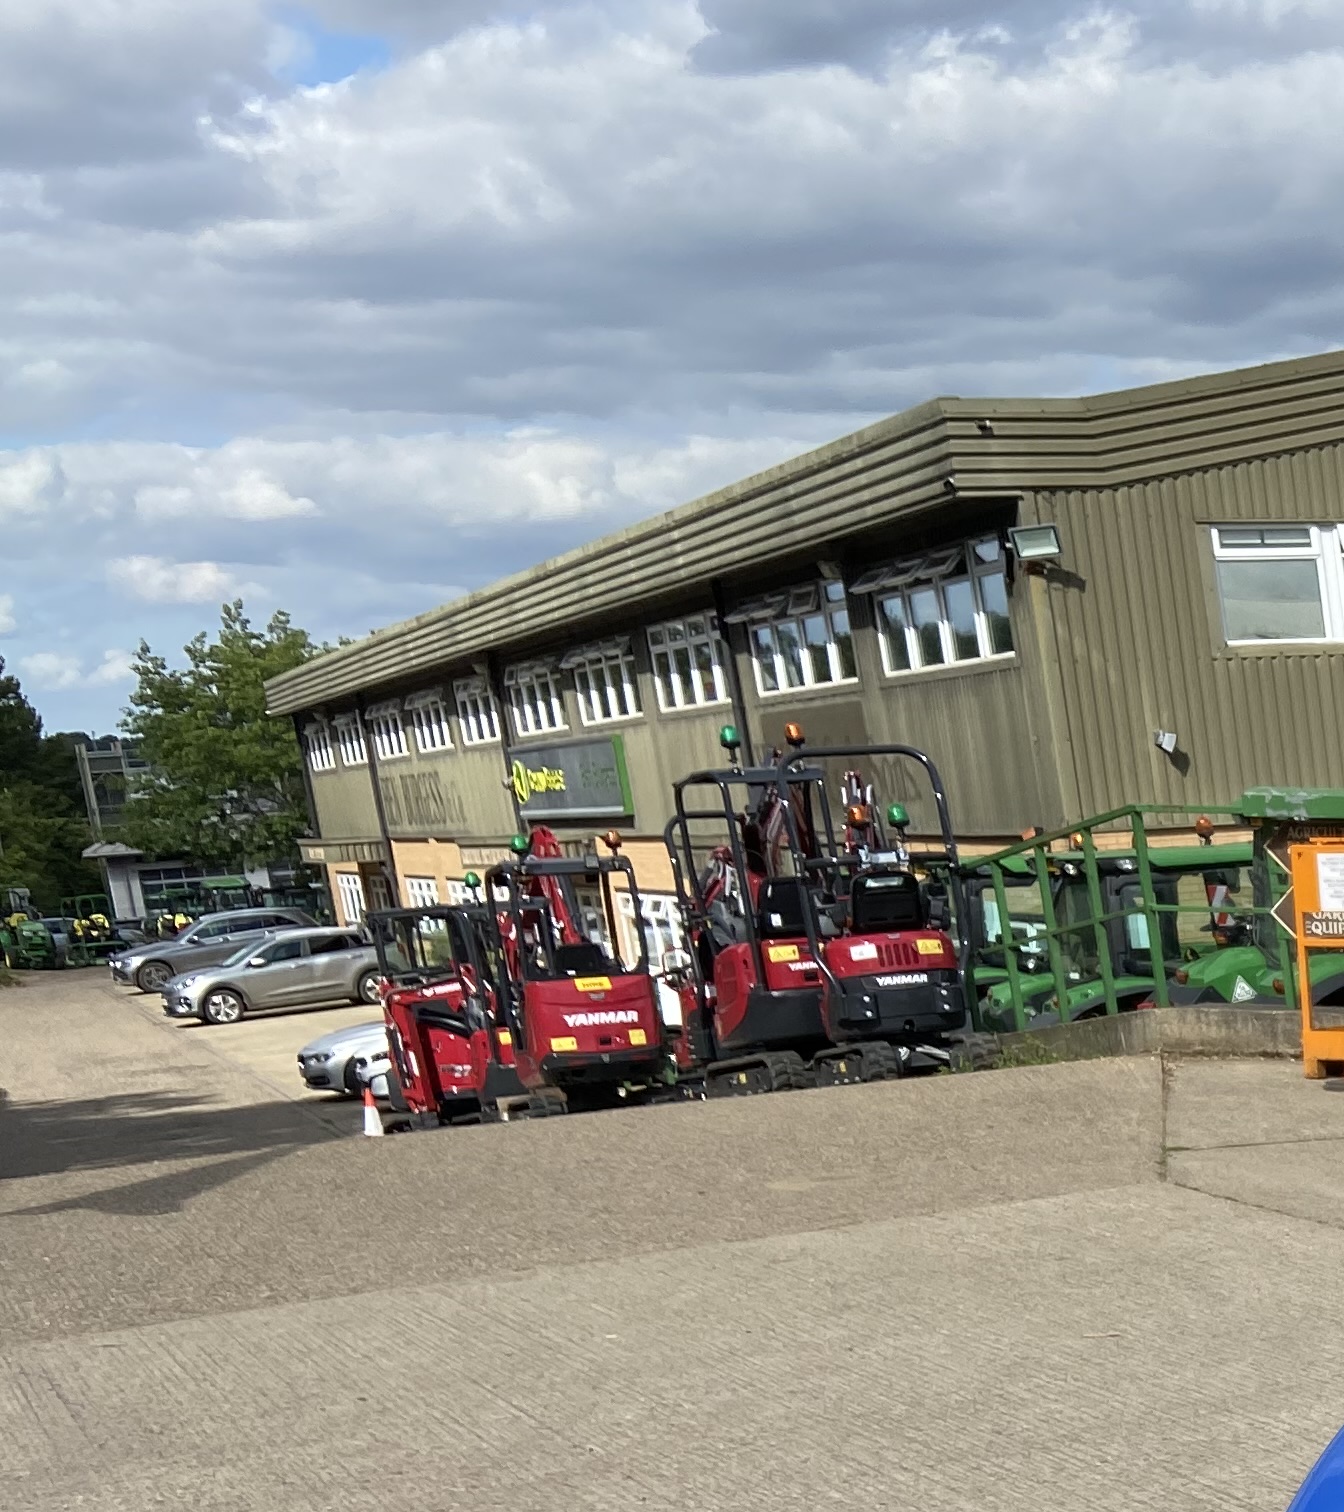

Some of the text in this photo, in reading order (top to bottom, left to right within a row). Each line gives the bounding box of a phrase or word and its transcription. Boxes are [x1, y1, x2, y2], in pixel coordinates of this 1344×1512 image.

[788, 962, 819, 971] YANM
[876, 973, 927, 987] YANMAR
[563, 1010, 638, 1027] YANMAR
